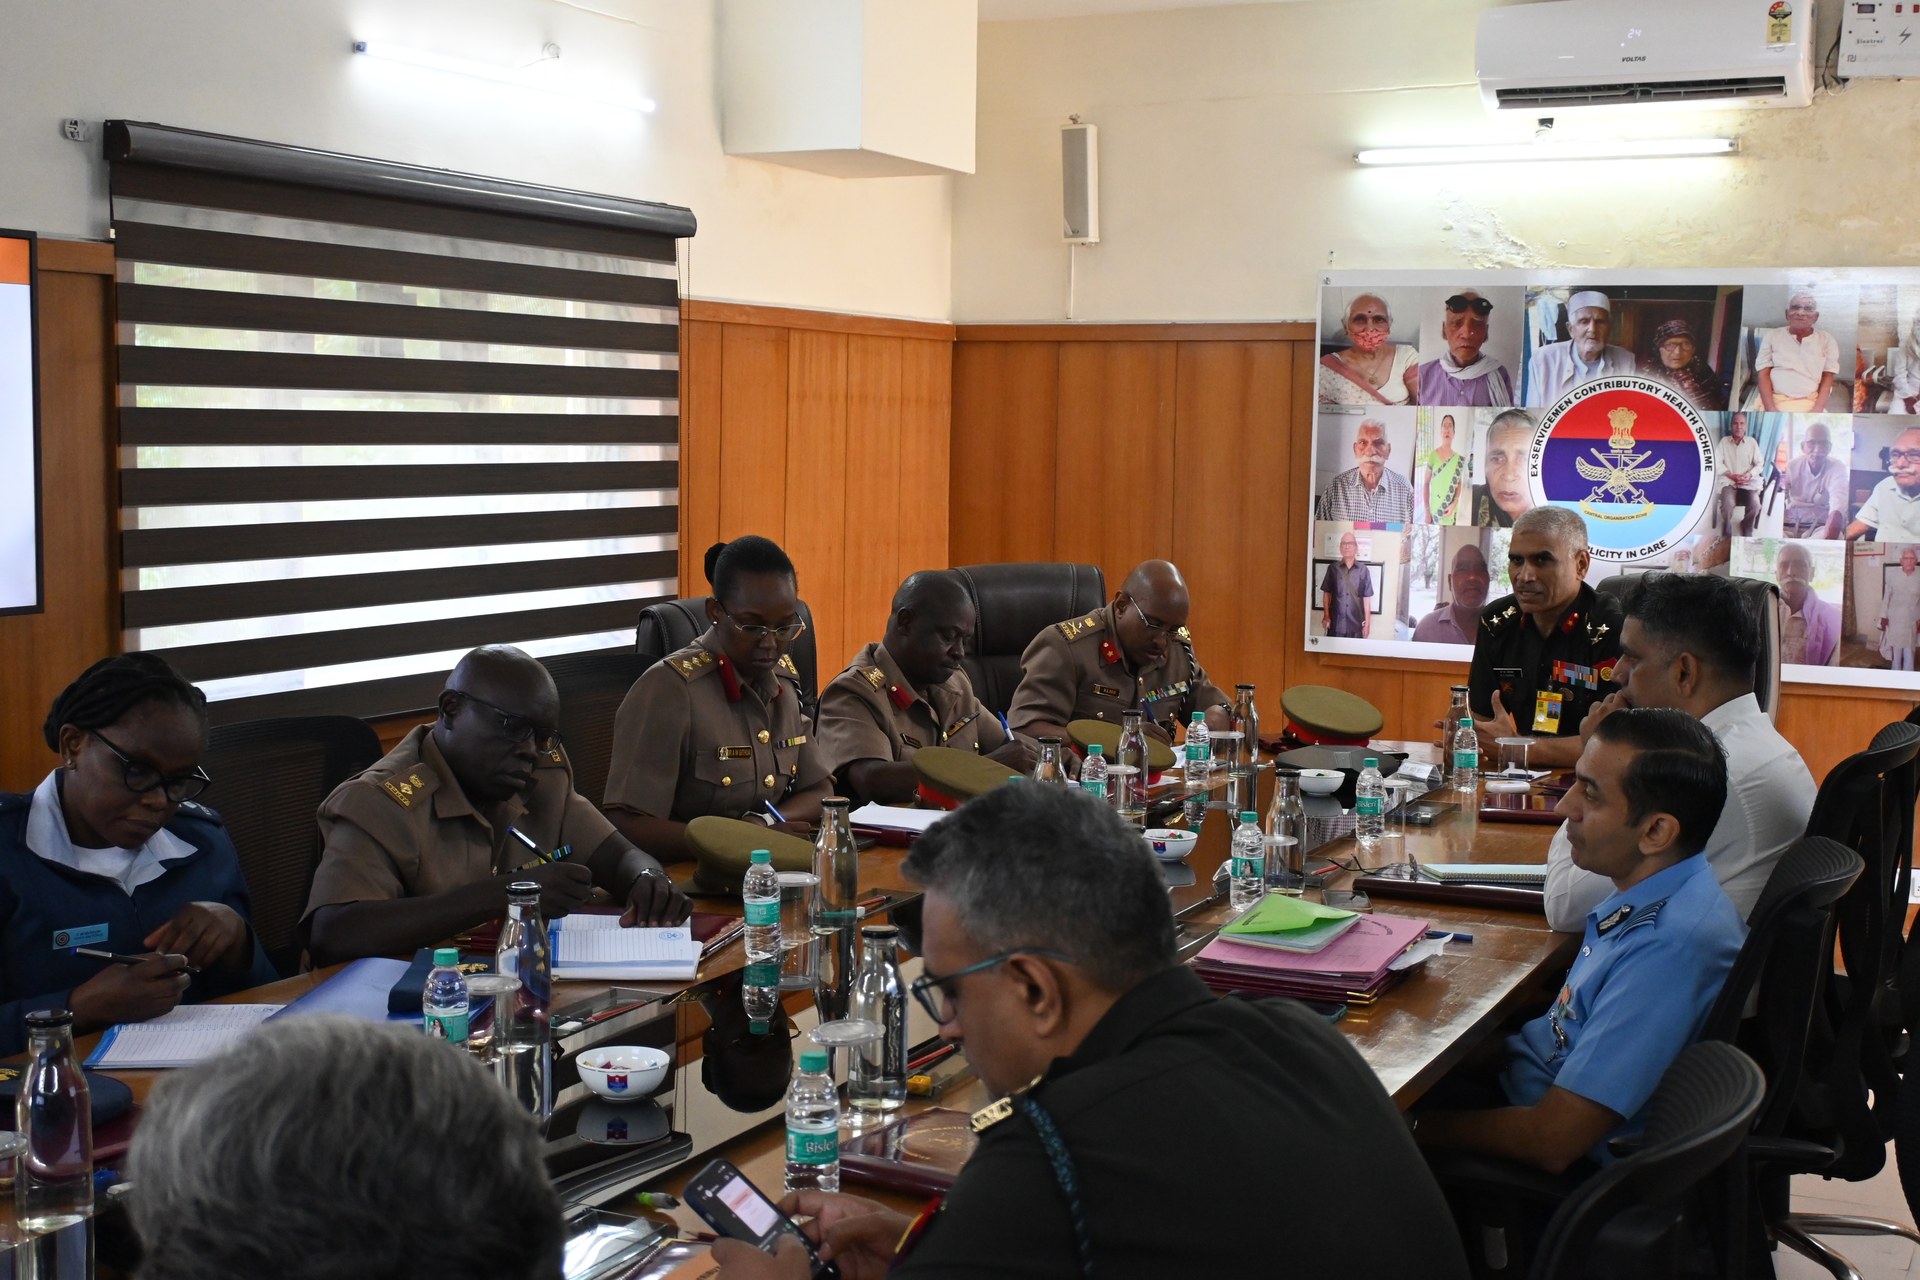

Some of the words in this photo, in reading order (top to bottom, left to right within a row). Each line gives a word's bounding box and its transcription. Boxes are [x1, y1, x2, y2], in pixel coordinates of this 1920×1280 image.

[1627, 28, 1642, 39] 24
[1530, 397, 1573, 477] EX-SERVICEMEN
[1573, 380, 1661, 400] CONTRIBUTORY
[1662, 391, 1699, 424] HEALTH
[1696, 426, 1713, 472] SCHEME
[1584, 510, 1602, 519] CENTRAL
[1626, 550, 1638, 559] IN
[1640, 539, 1668, 556] CARE
